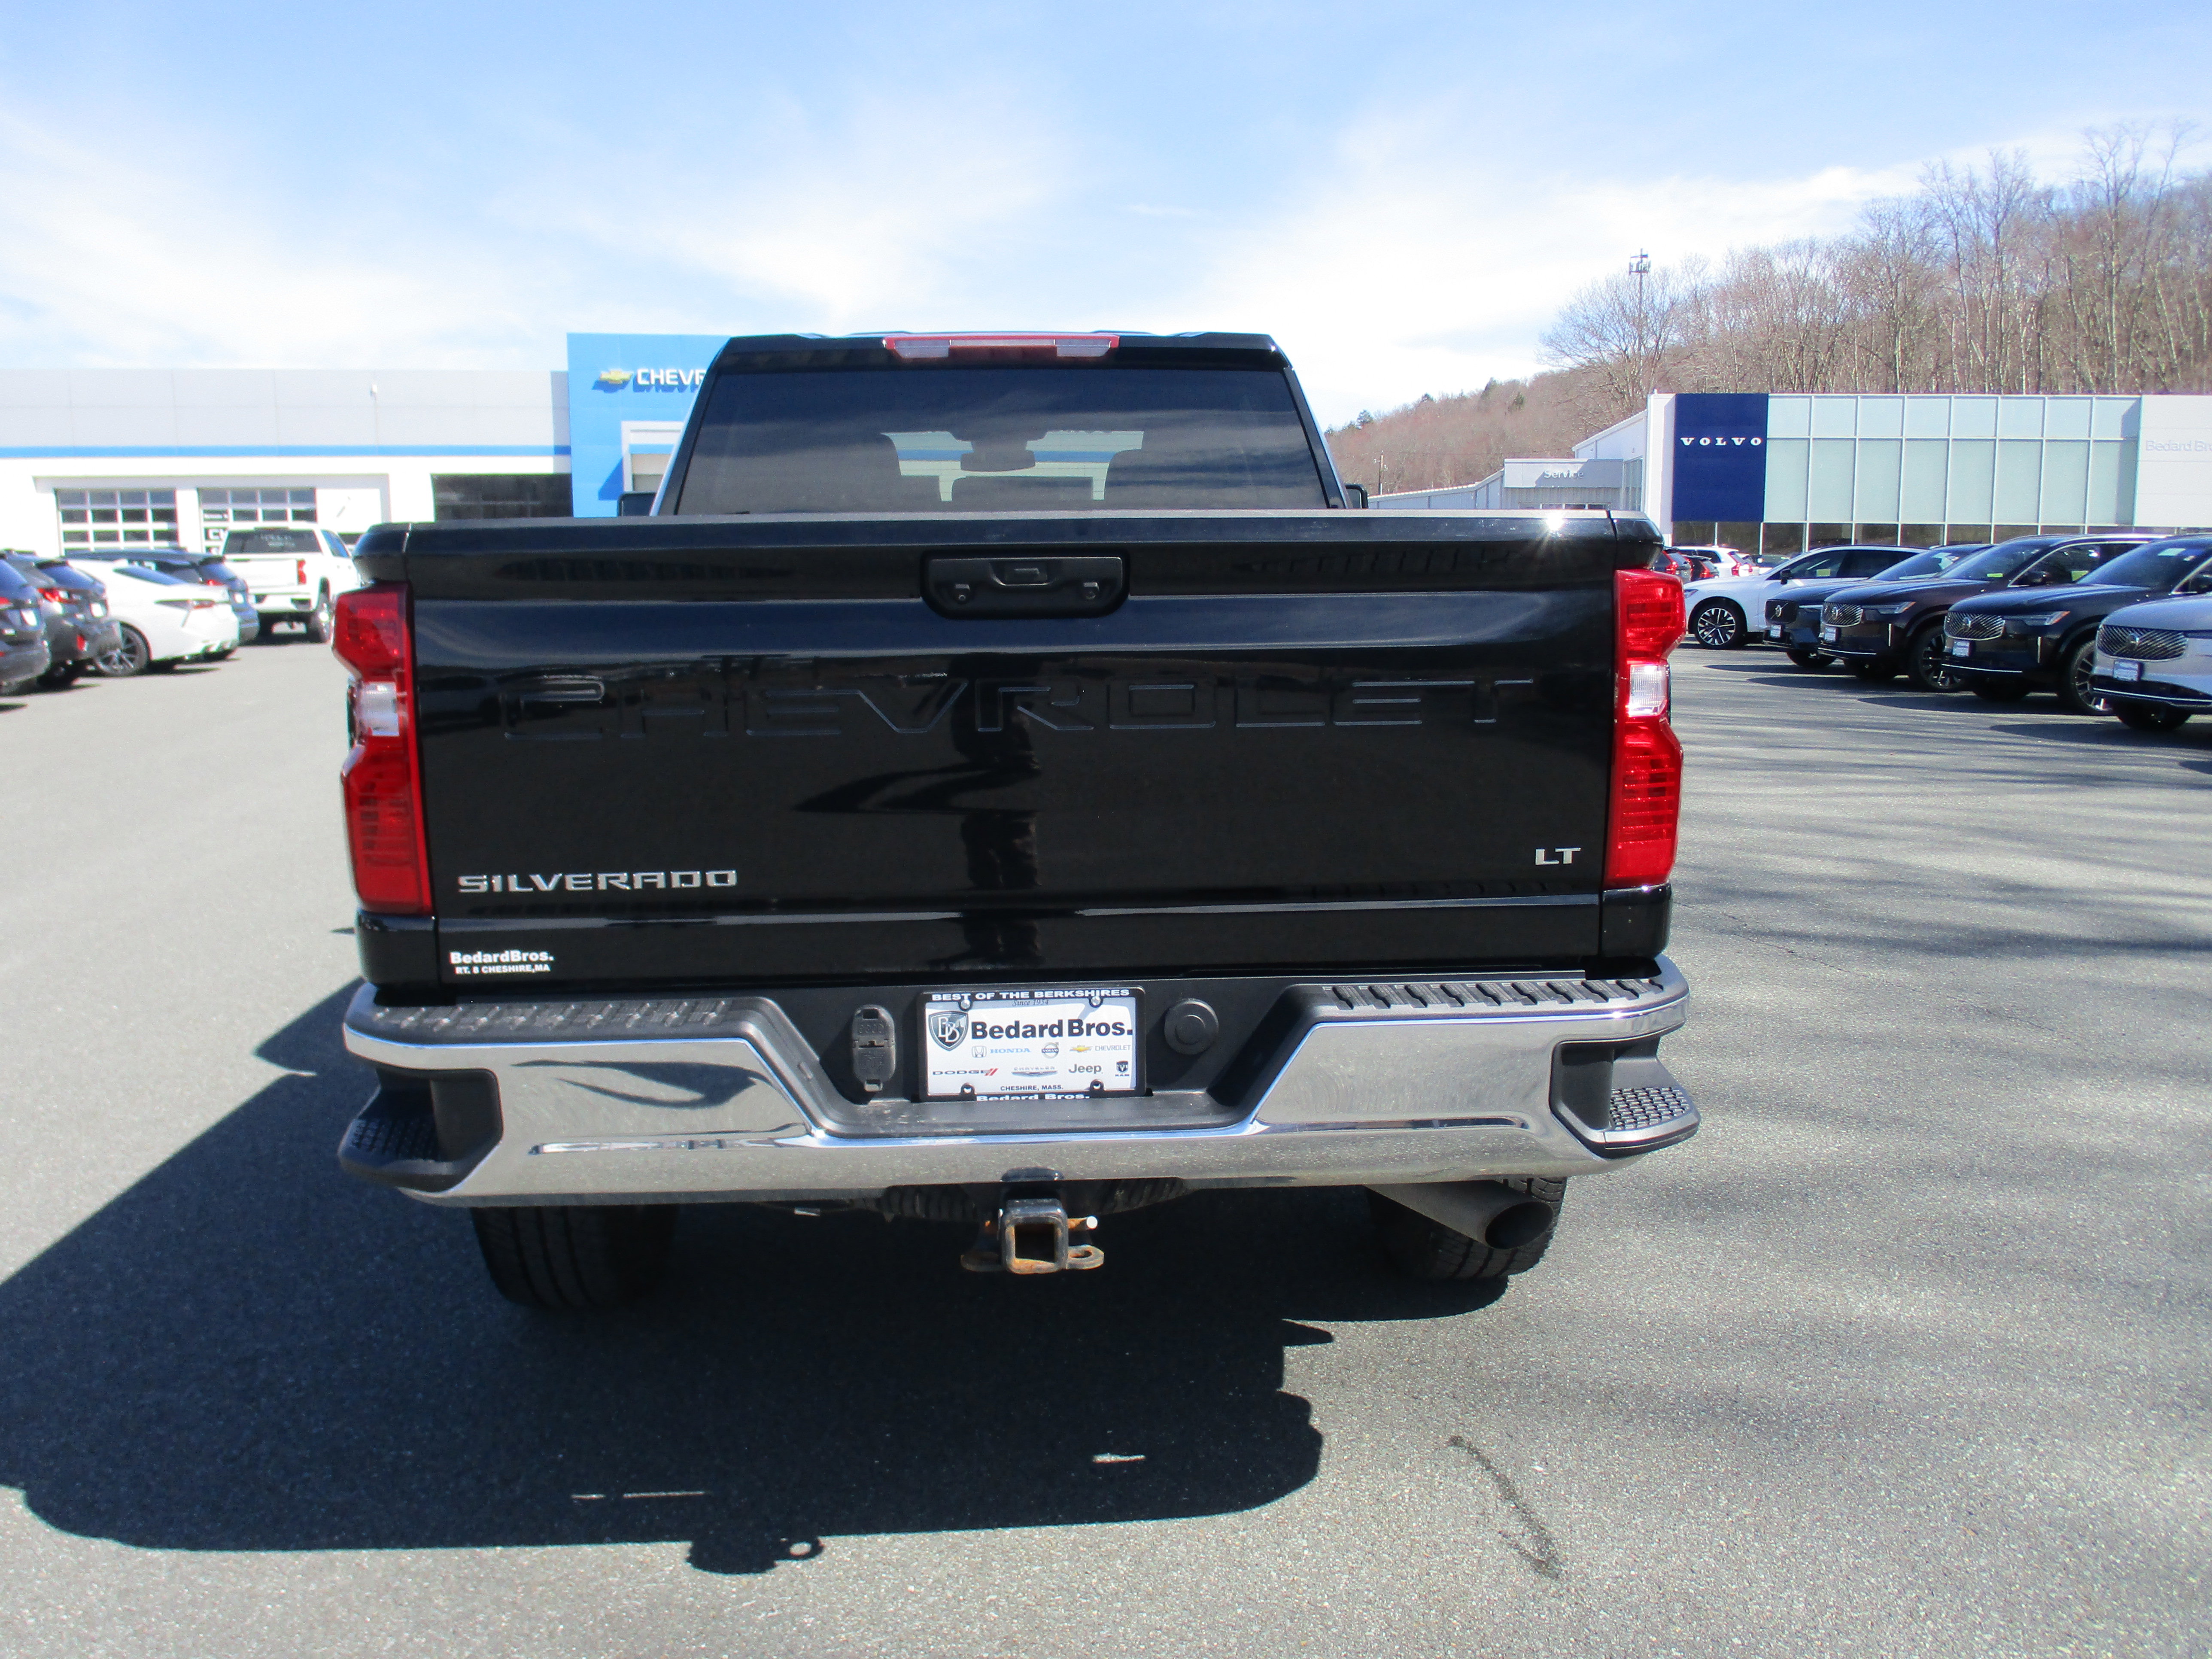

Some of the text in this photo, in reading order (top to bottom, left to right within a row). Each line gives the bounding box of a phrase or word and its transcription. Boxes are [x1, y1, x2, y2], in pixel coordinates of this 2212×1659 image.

[1680, 437, 1762, 446] VOLVO
[2145, 440, 2192, 451] Bedard
[1544, 468, 1583, 479] Service
[503, 674, 1534, 739] CHEVROLET
[1535, 847, 1581, 865] LT
[458, 869, 737, 893] SILVERADO
[455, 966, 471, 975] RT.
[472, 966, 480, 974] 8
[1034, 989, 1130, 998] BERKSHIRES
[971, 1019, 1133, 1039] Bedard Bros.
[1068, 1063, 1102, 1074] Jeep
